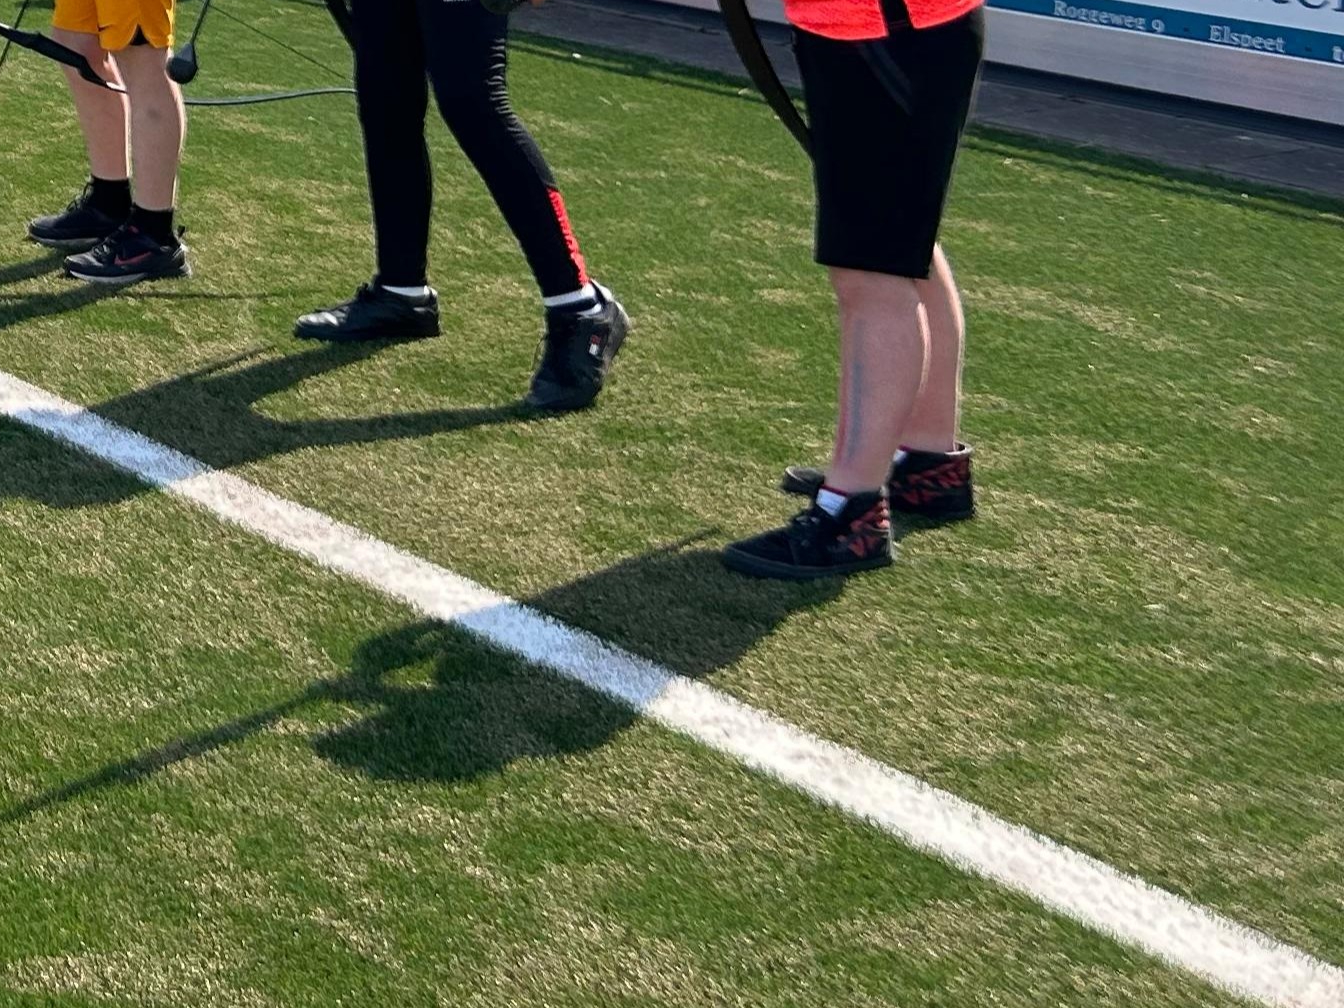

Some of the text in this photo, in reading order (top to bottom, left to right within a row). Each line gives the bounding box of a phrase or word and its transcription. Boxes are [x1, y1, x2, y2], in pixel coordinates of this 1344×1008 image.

[1053, 0, 1147, 31] Roggeweg
[1151, 18, 1166, 33] 9
[1208, 23, 1287, 55] Elspeet
